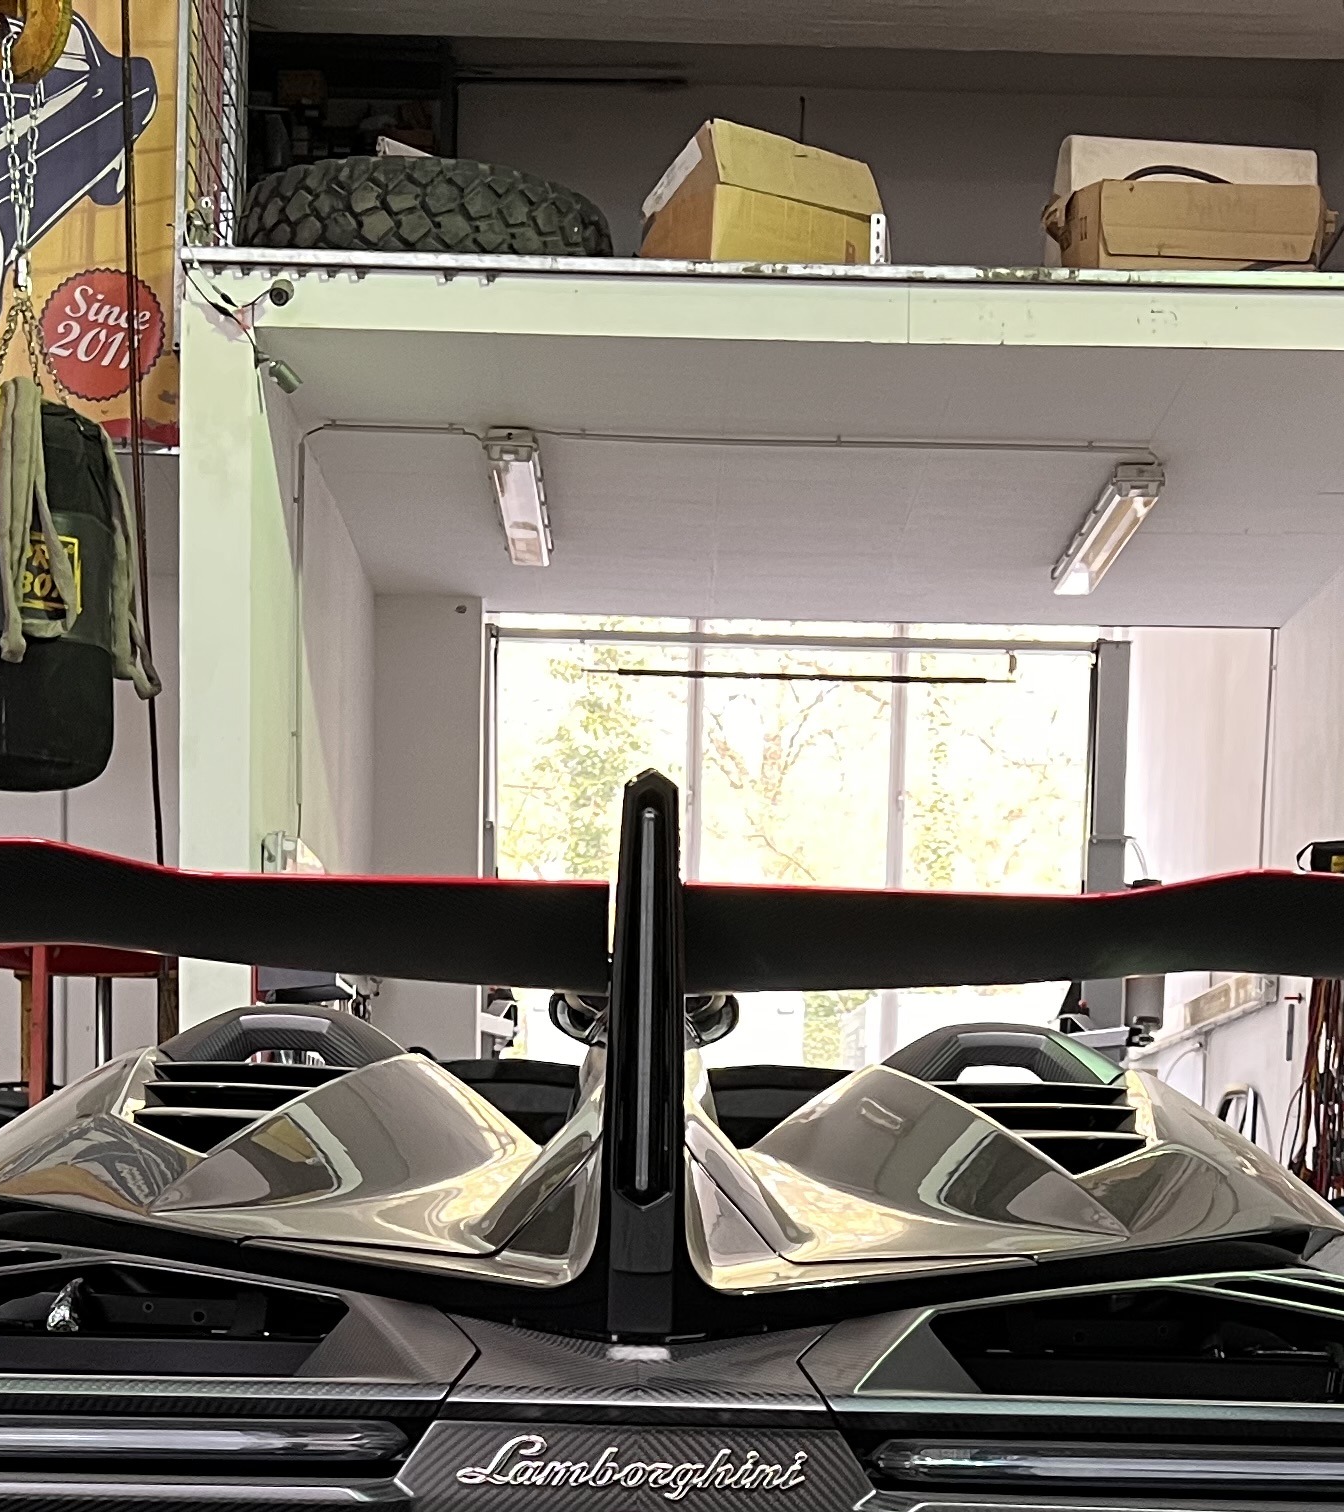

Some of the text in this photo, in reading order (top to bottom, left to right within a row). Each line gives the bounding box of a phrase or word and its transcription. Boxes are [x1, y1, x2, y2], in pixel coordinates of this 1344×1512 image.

[64, 285, 152, 331] Since
[22, 570, 60, 598] BO
[455, 1433, 809, 1501] Lamborghini
